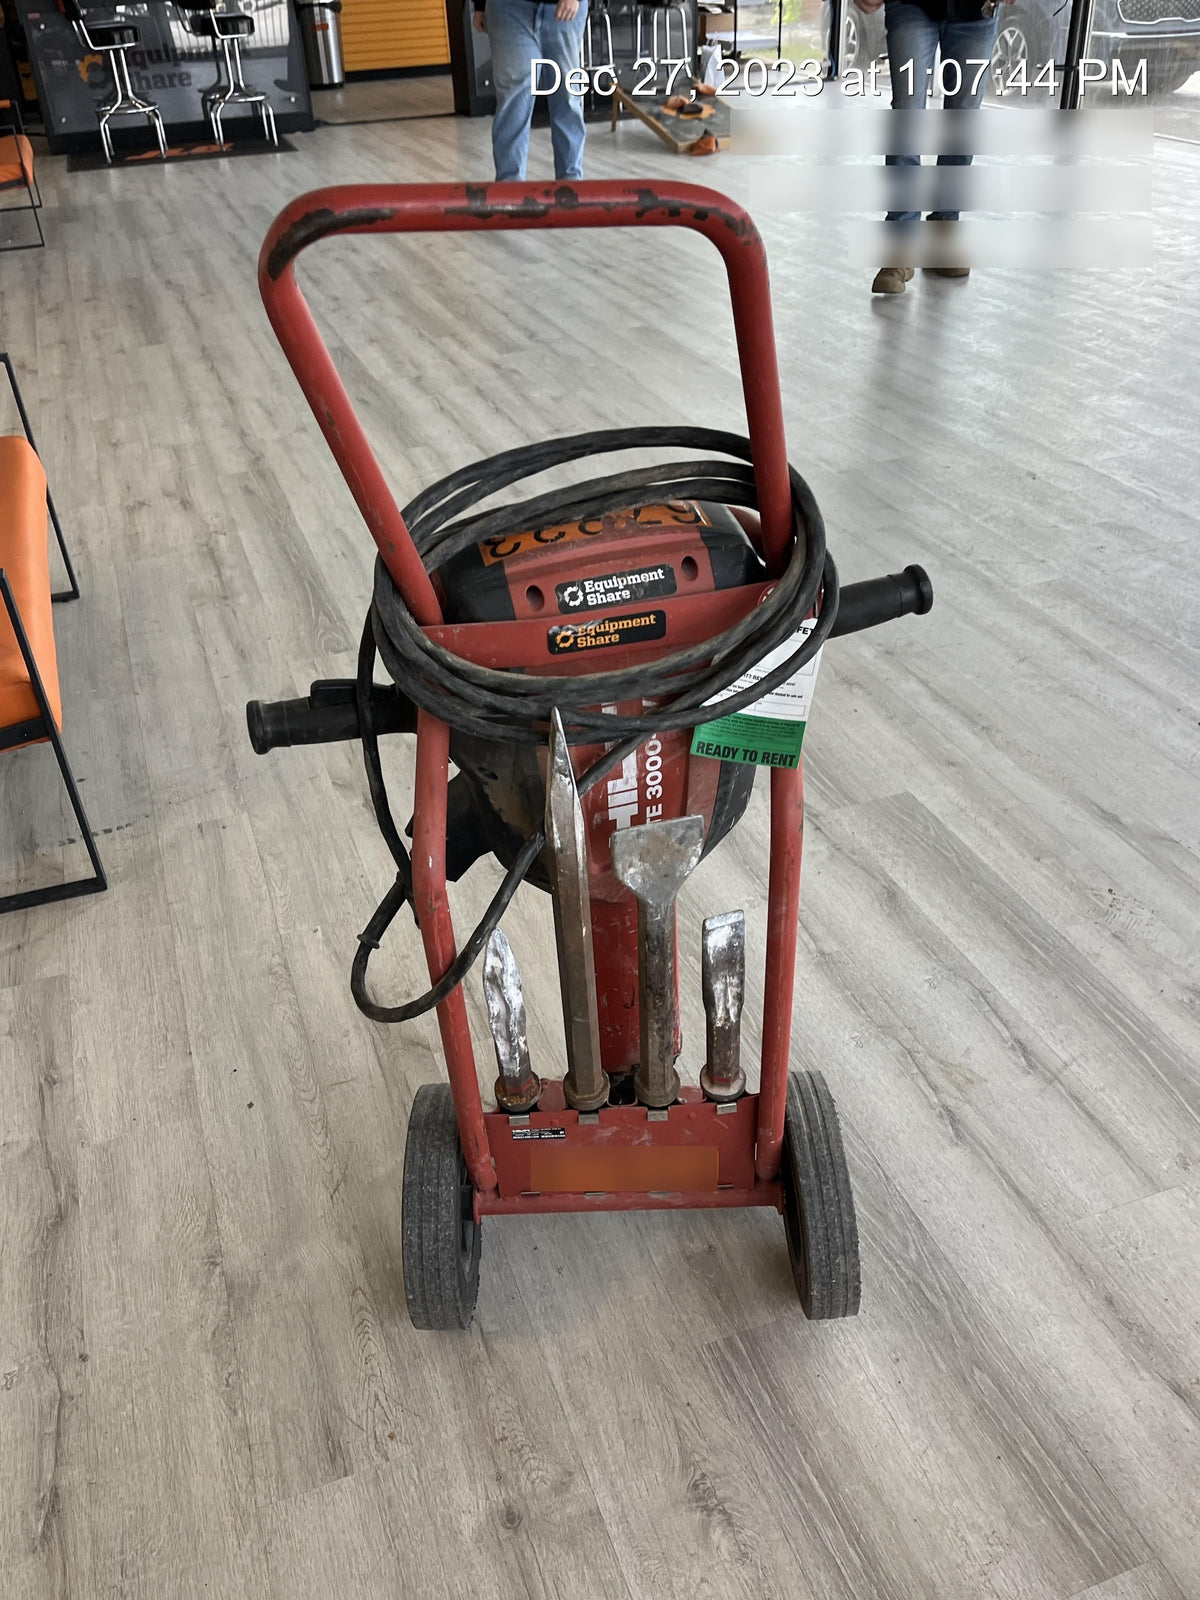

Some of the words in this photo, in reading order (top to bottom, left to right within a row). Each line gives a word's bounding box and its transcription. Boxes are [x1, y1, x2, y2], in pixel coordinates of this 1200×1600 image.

[129, 69, 193, 92] hare
[583, 568, 666, 592] Equipment
[587, 589, 631, 606] Share
[578, 613, 657, 636] Equipment
[577, 633, 620, 648] Share
[695, 740, 739, 760] READY
[742, 748, 759, 763] TO
[761, 751, 797, 767] RENT
